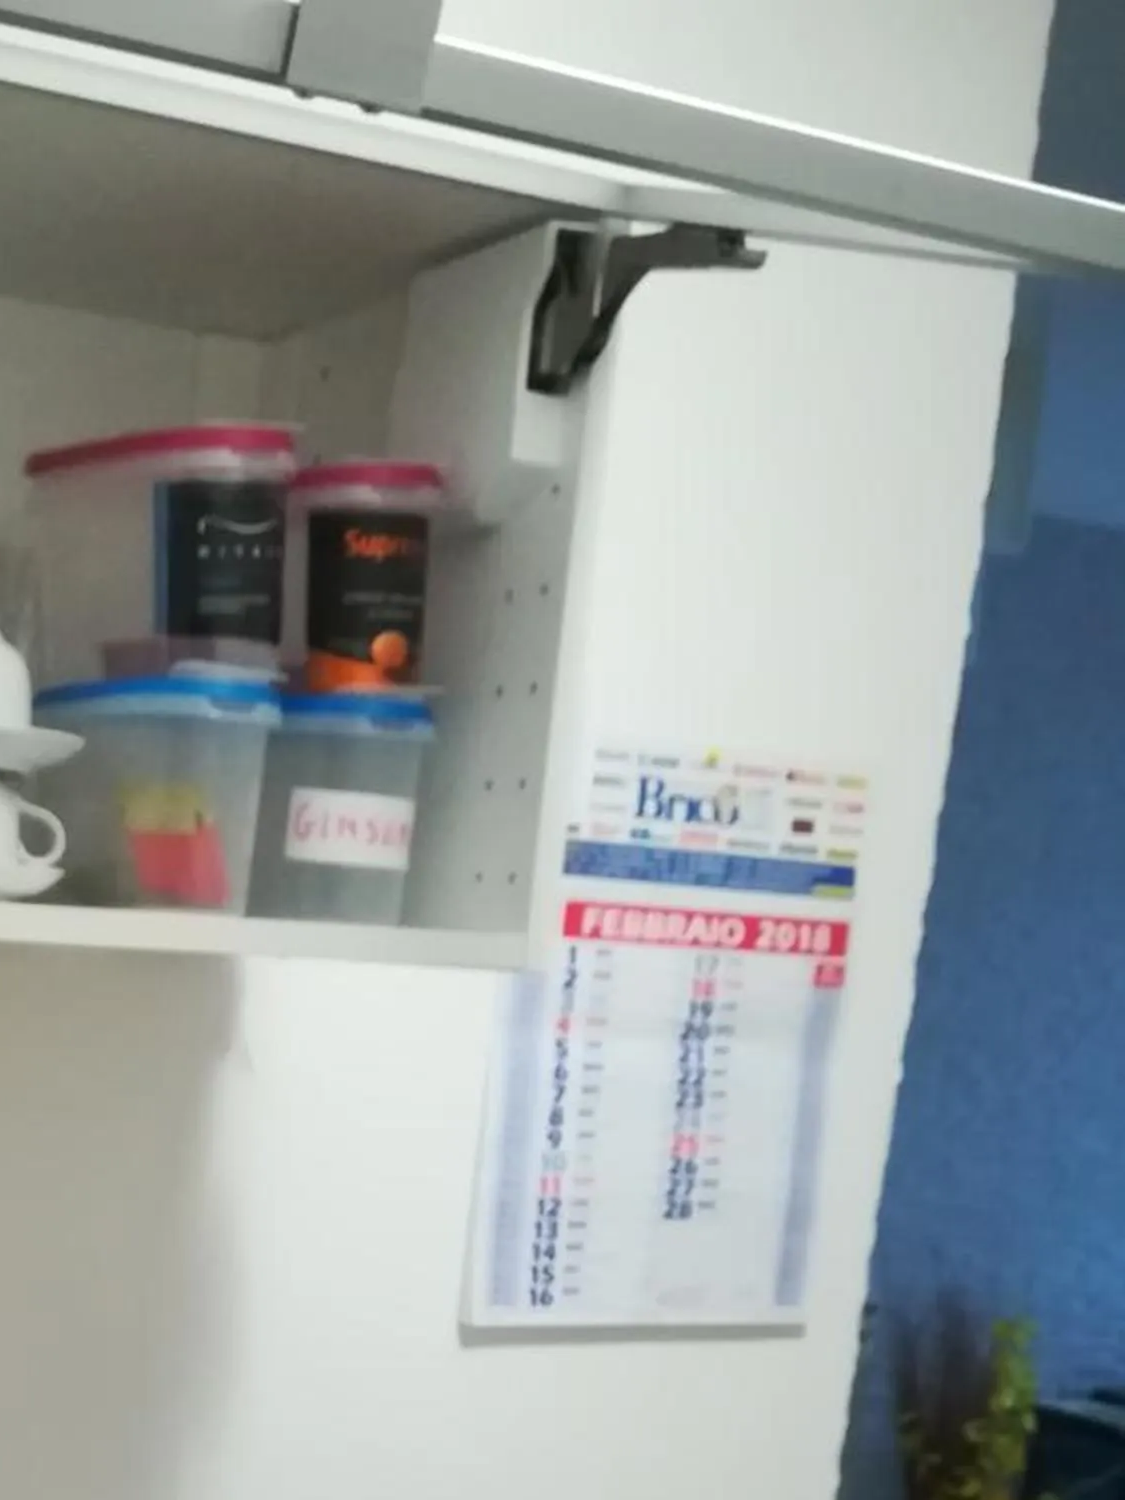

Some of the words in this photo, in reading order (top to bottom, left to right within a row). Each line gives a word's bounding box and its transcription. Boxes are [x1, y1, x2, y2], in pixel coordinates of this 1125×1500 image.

[581, 906, 747, 947] FEBBRAIO
[755, 920, 832, 954] 2018
[538, 1198, 562, 1217] 12
[531, 1264, 555, 1284] 15
[529, 1287, 554, 1307] 16
